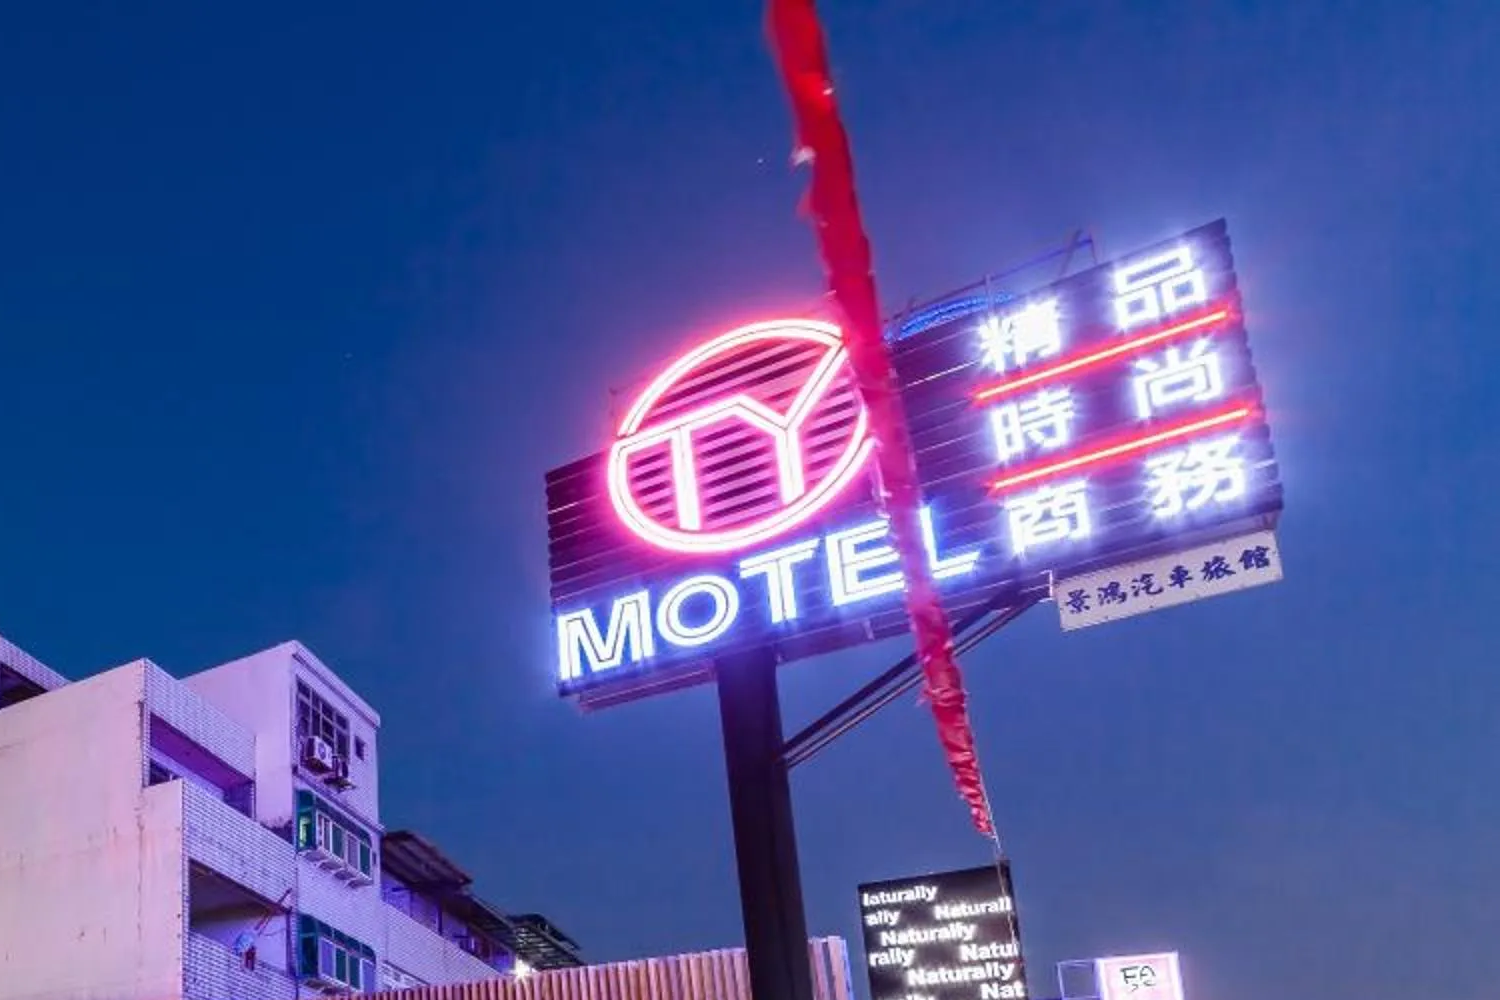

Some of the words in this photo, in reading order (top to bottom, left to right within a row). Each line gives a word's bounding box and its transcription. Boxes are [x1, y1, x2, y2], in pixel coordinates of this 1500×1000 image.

[979, 245, 1212, 376] 精品
[614, 338, 850, 532] TY
[994, 345, 1225, 463] 時尚
[1006, 444, 1250, 556] 商務
[556, 502, 982, 682] MOTEL
[1065, 545, 1271, 614] 景鴻汽車旅館
[869, 948, 915, 967] rally
[880, 922, 977, 948] Naturally
[907, 961, 1015, 986] Naturally
